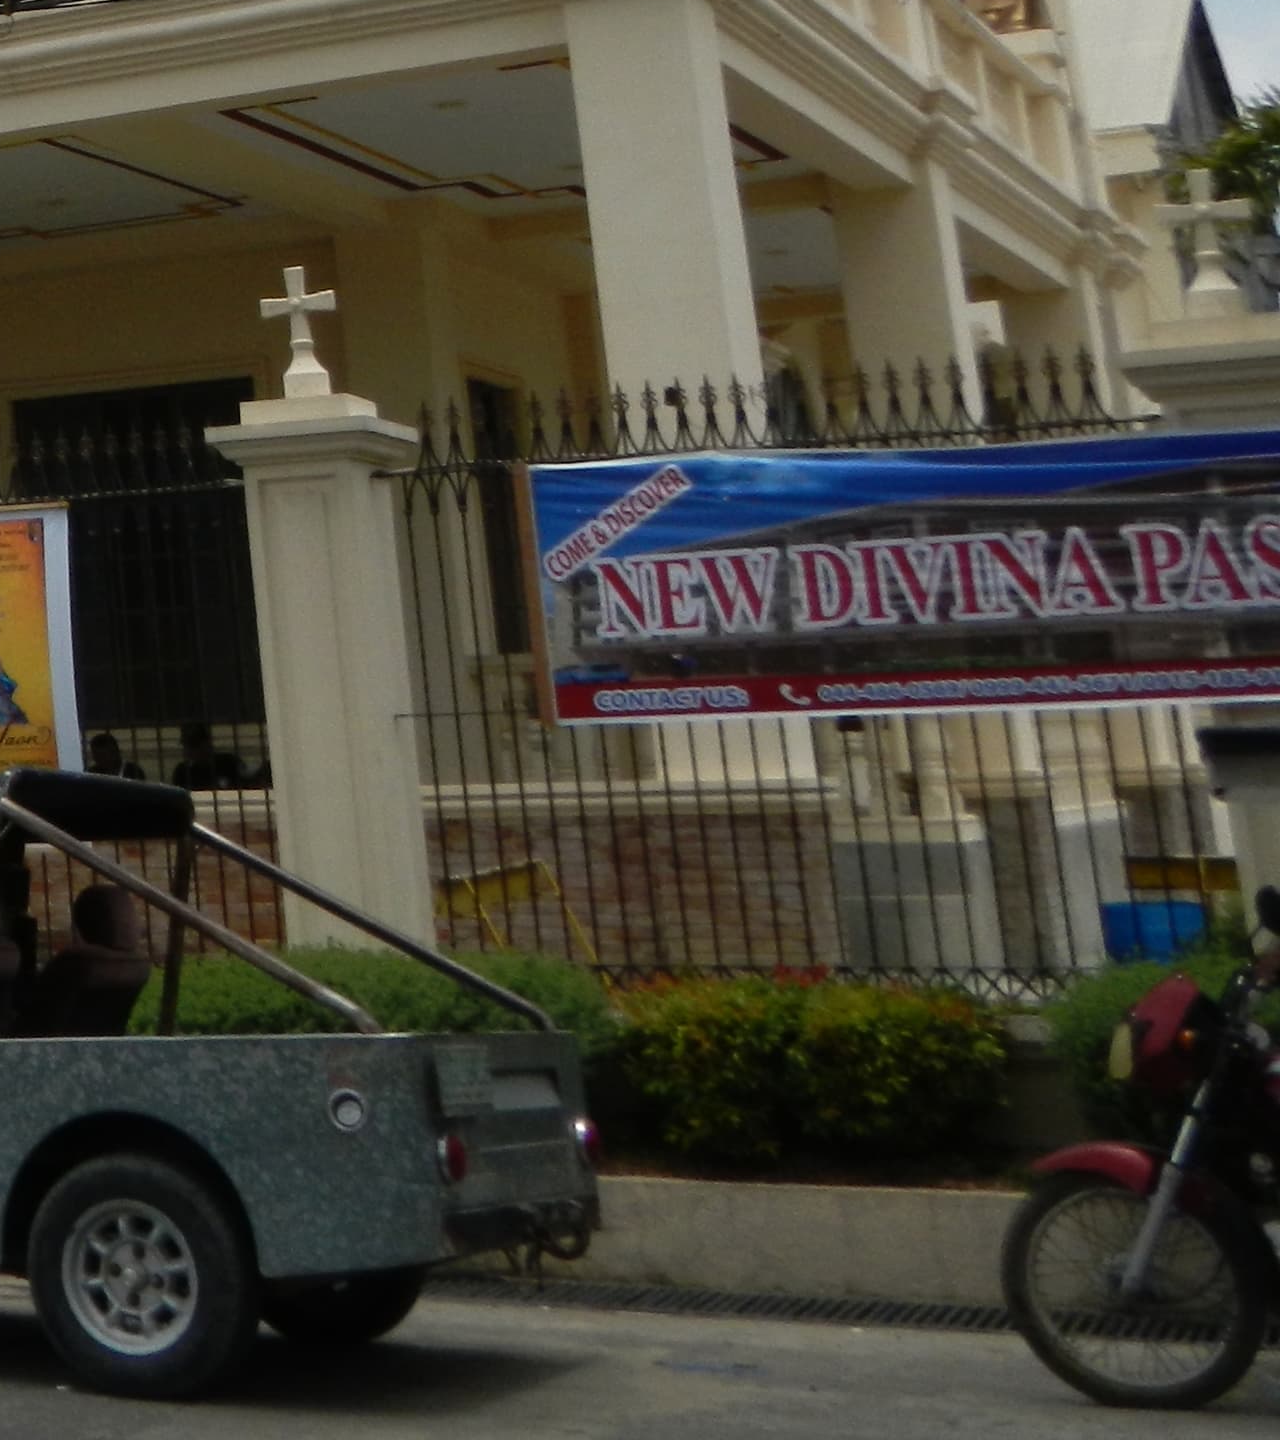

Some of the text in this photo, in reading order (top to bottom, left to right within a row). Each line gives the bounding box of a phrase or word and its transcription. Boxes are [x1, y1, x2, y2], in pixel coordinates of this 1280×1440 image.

[546, 467, 686, 578] COME & DISCOVER
[594, 550, 776, 635] NEW
[793, 532, 1118, 625] DIVINA
[596, 686, 749, 709] CONTACT US:
